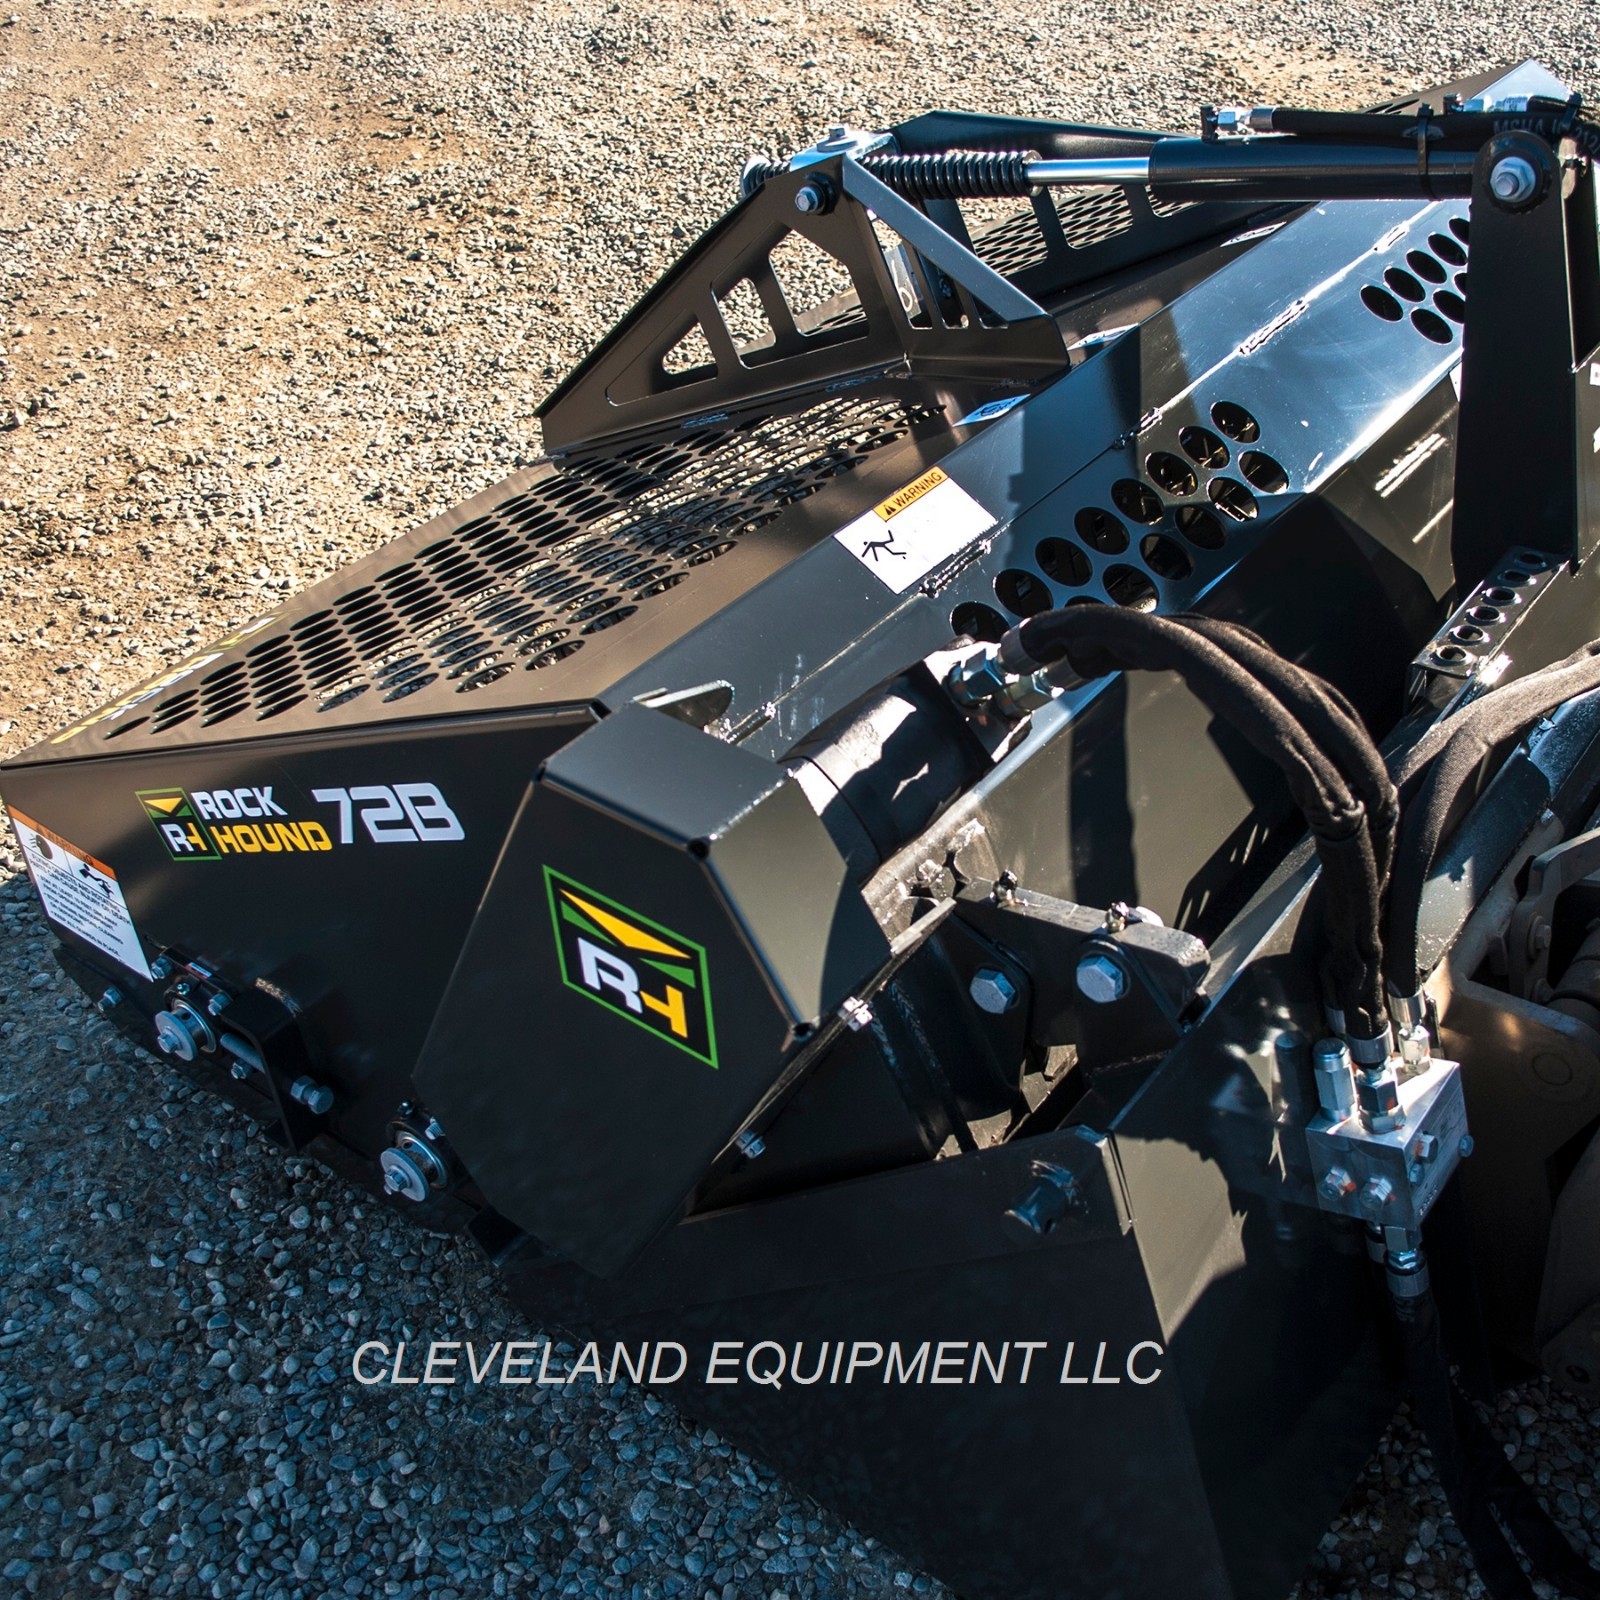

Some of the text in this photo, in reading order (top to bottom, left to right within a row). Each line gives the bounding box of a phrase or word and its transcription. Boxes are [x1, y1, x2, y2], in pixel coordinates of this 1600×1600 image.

[893, 471, 943, 508] WARNING
[161, 821, 333, 853] RH HOUND
[190, 782, 465, 843] ROCK 72B
[577, 936, 689, 1039] RH
